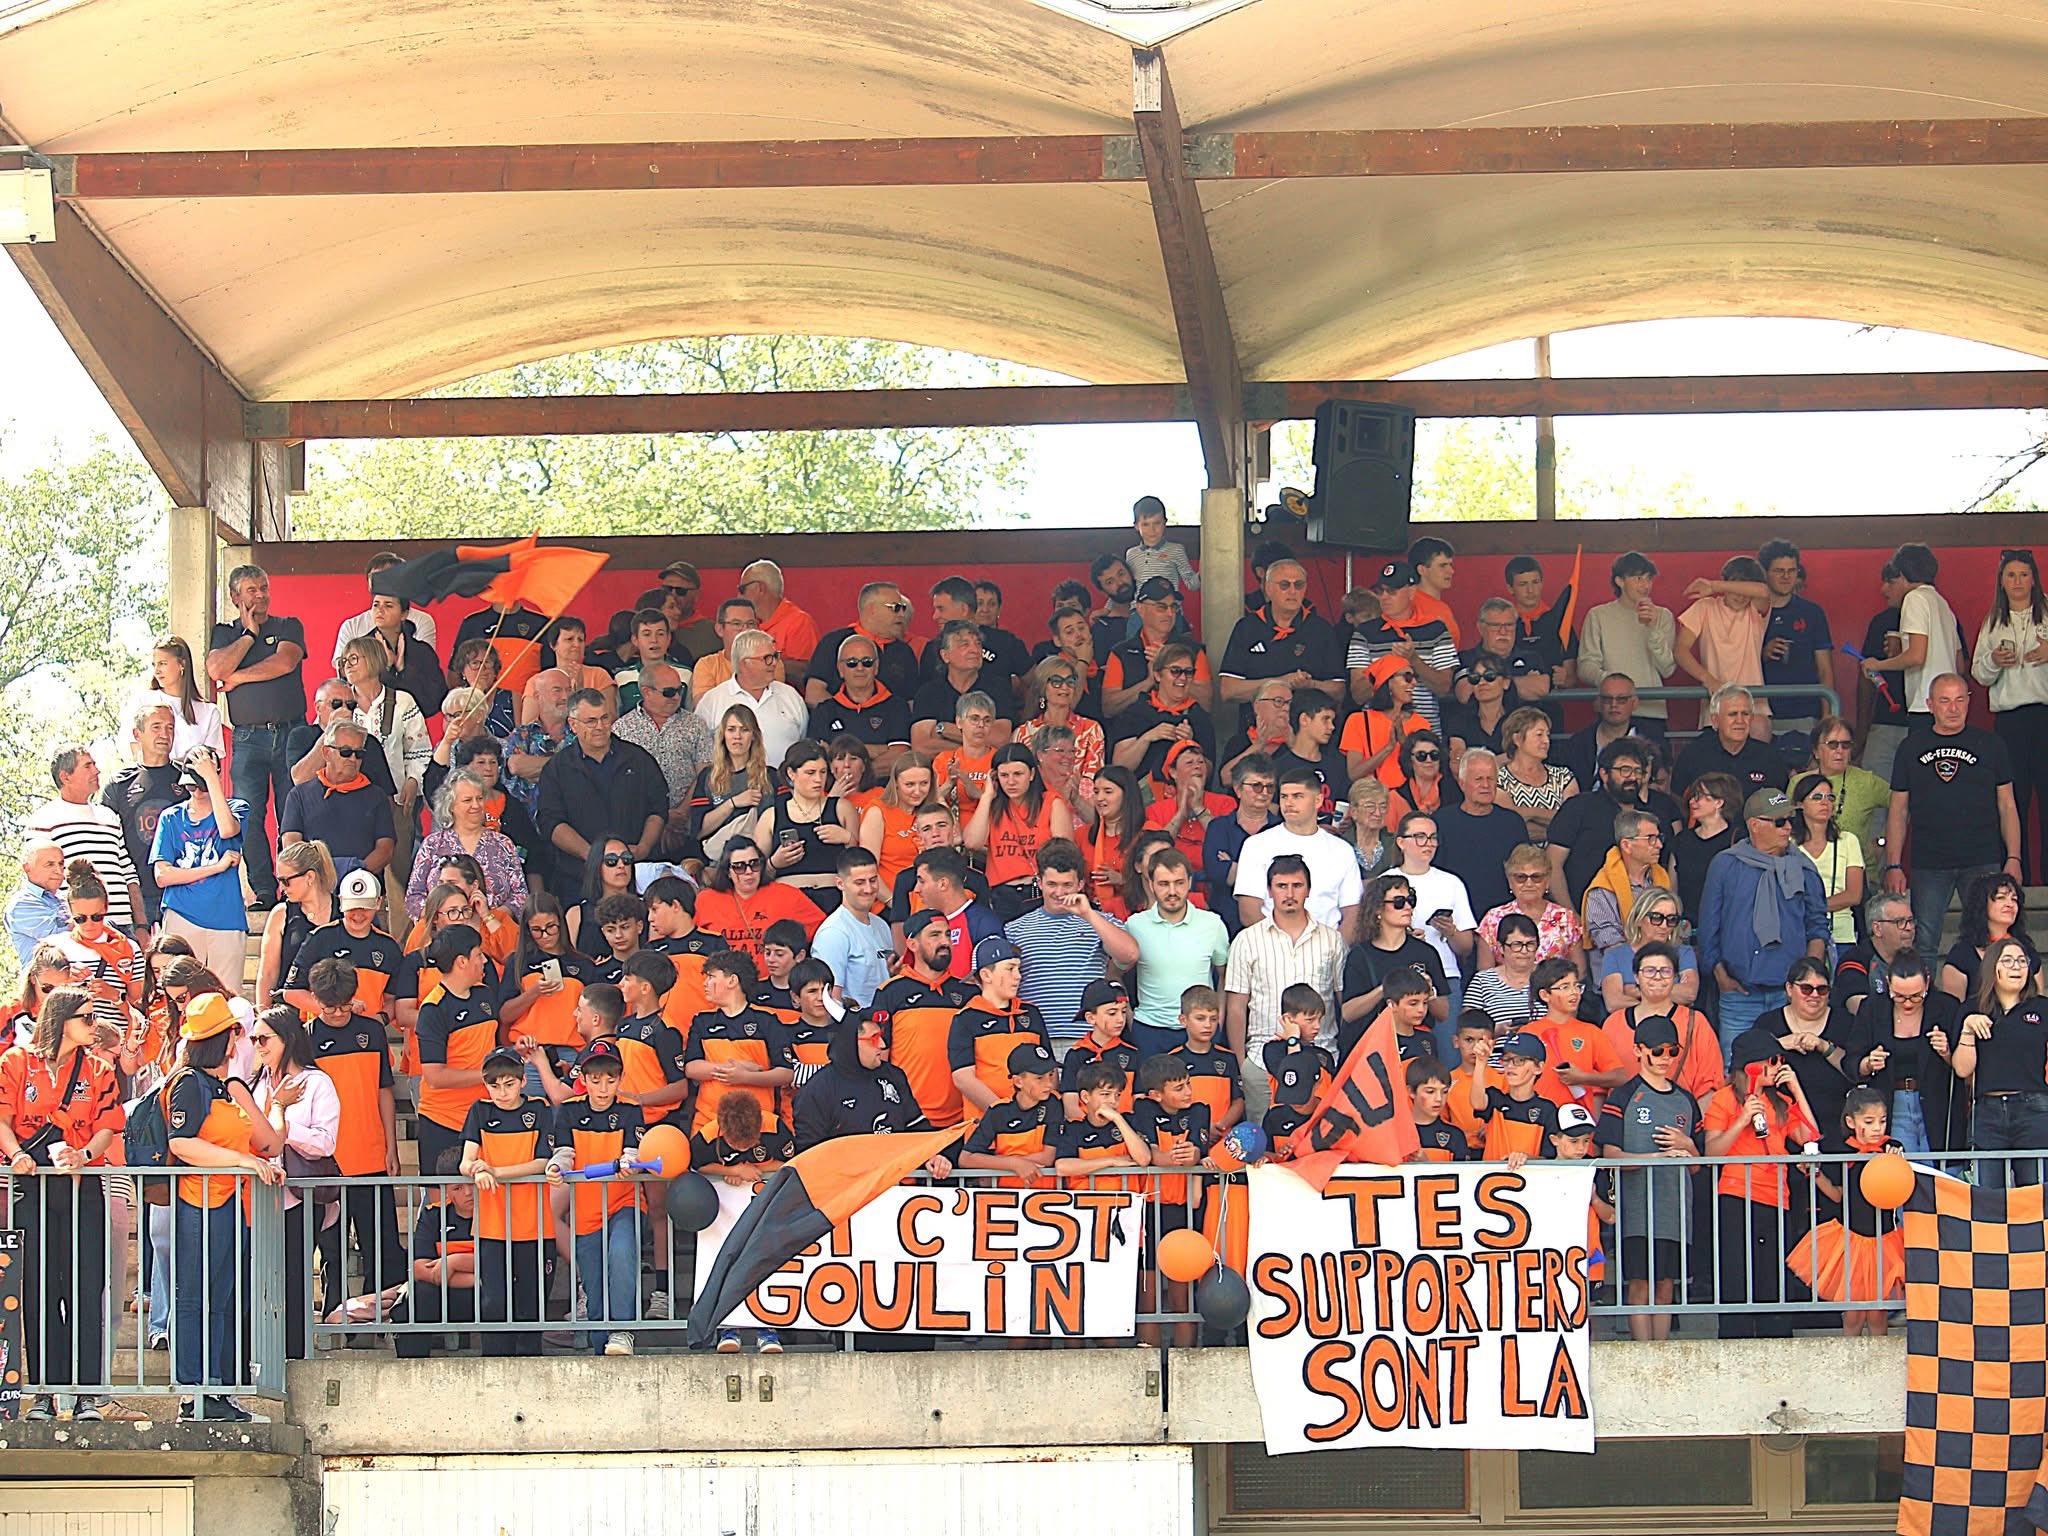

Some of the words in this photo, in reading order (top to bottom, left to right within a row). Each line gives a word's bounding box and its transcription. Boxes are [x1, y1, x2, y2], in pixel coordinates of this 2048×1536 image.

[1919, 748, 1977, 764] VIC-FEZENSAC
[897, 1188, 1132, 1262] C'EST
[1322, 1173, 1532, 1250] TES
[1253, 1247, 1588, 1339] SUPPORTERS
[1303, 1334, 1479, 1442] SONT
[1501, 1334, 1589, 1418] LA
